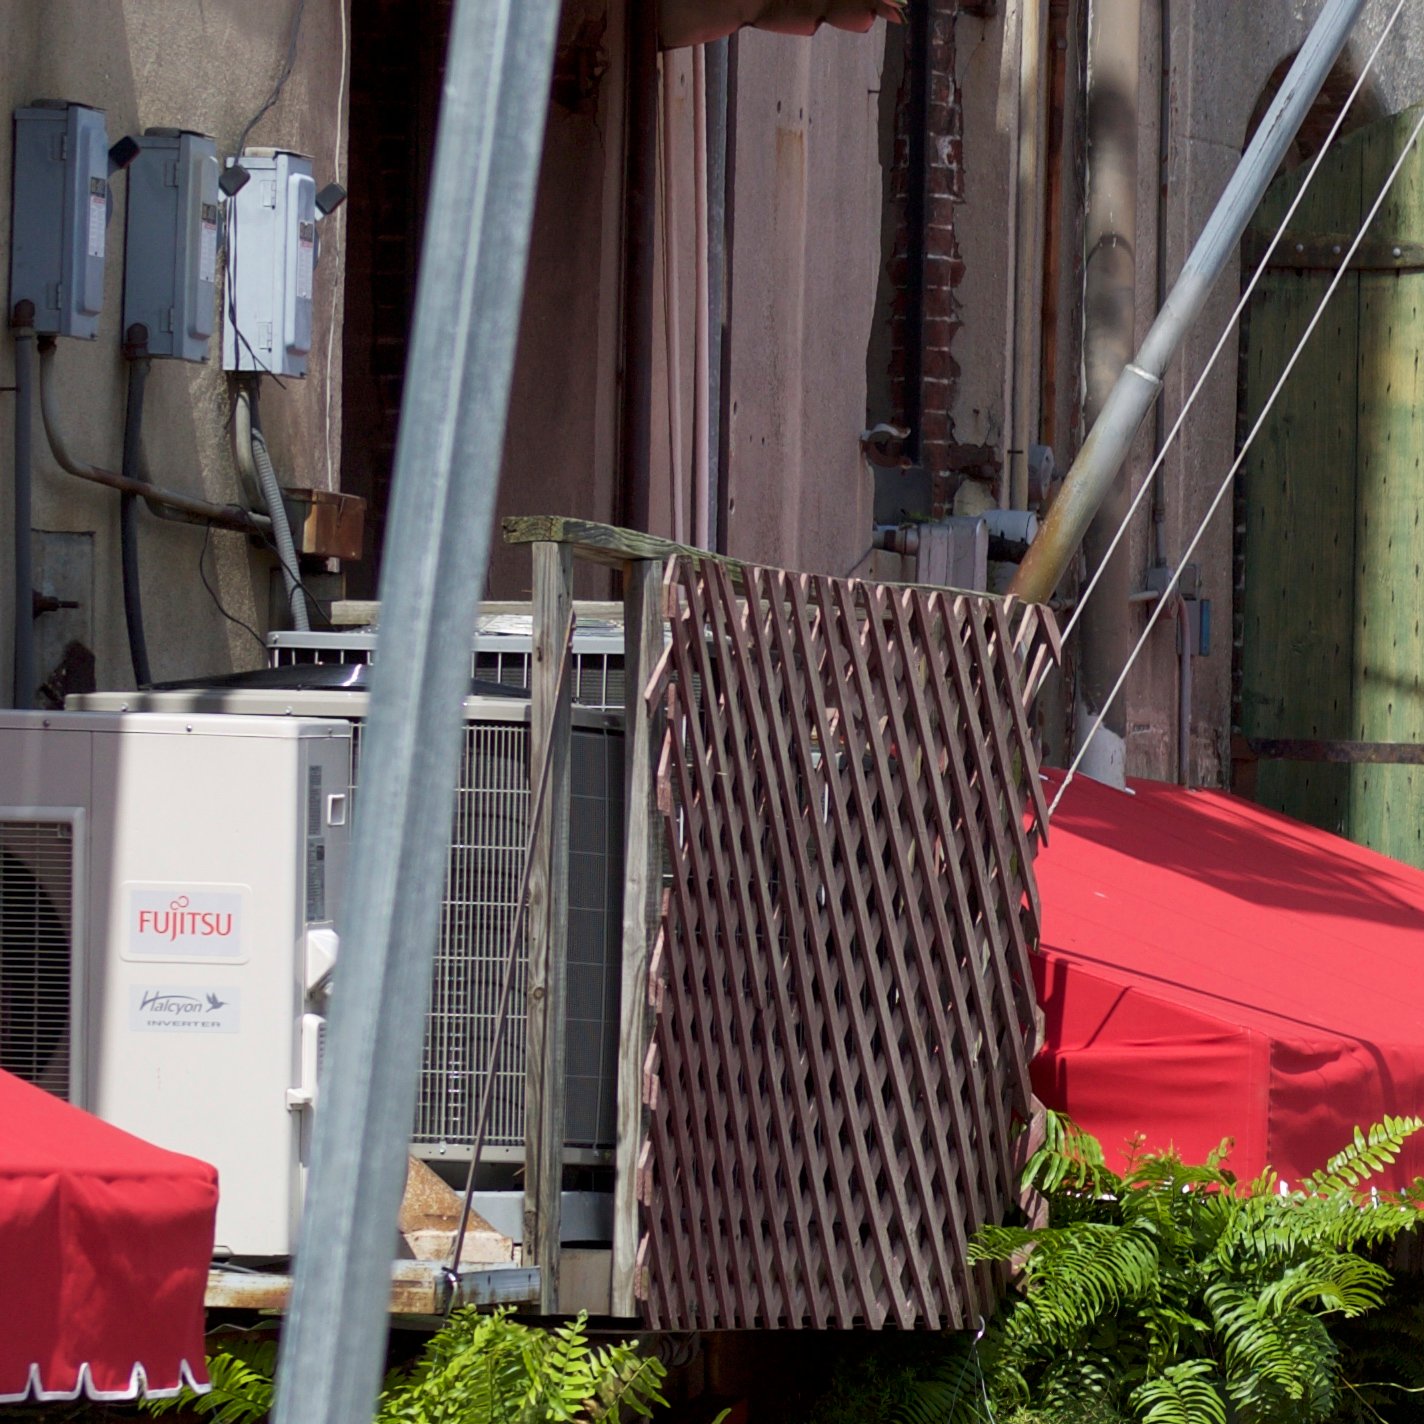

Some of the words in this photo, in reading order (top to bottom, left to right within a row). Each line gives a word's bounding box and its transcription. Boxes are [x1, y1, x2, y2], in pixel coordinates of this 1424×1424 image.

[138, 909, 232, 943] FUJITSU
[138, 989, 203, 1017] Halcyon
[146, 1019, 222, 1028] INVERTER
